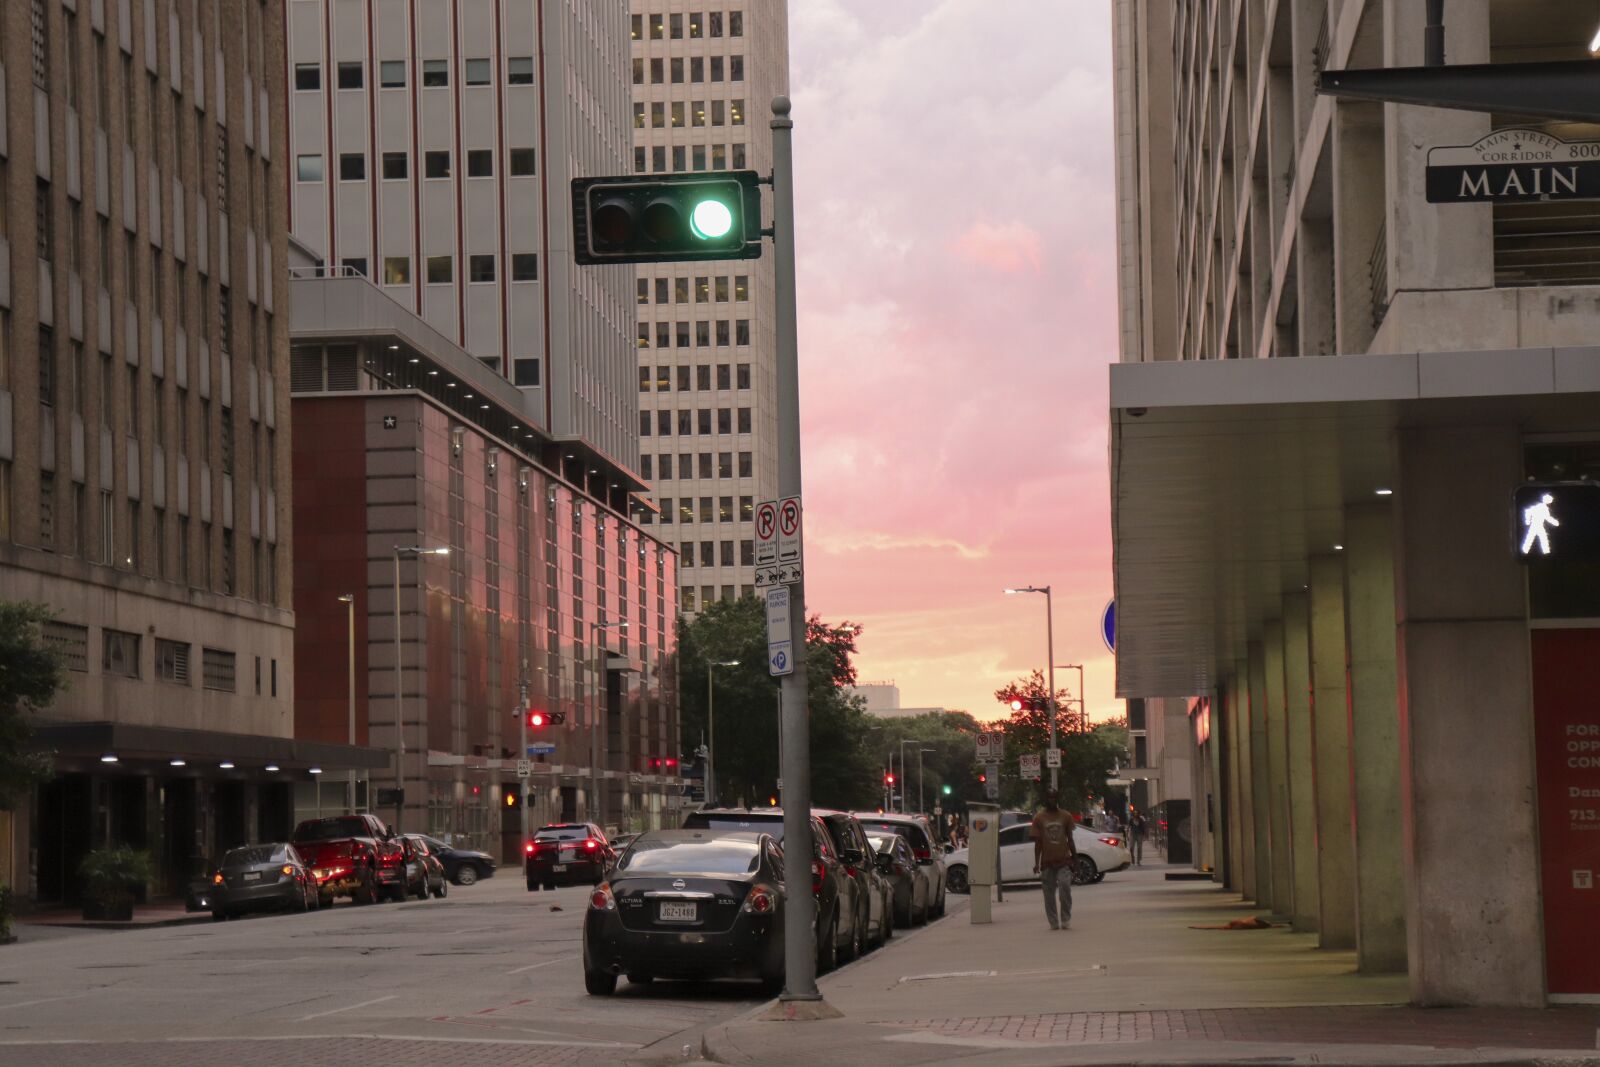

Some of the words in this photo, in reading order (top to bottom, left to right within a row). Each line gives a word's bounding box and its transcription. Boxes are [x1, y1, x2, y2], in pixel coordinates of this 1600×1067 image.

[1475, 133, 1509, 153] MAIN
[1514, 132, 1561, 150] STREET
[1482, 151, 1553, 162] CORRIDOR
[1569, 143, 1600, 158] 800
[1458, 166, 1579, 197] MAIN
[769, 600, 787, 609] PARKING
[1566, 724, 1600, 736] FOR
